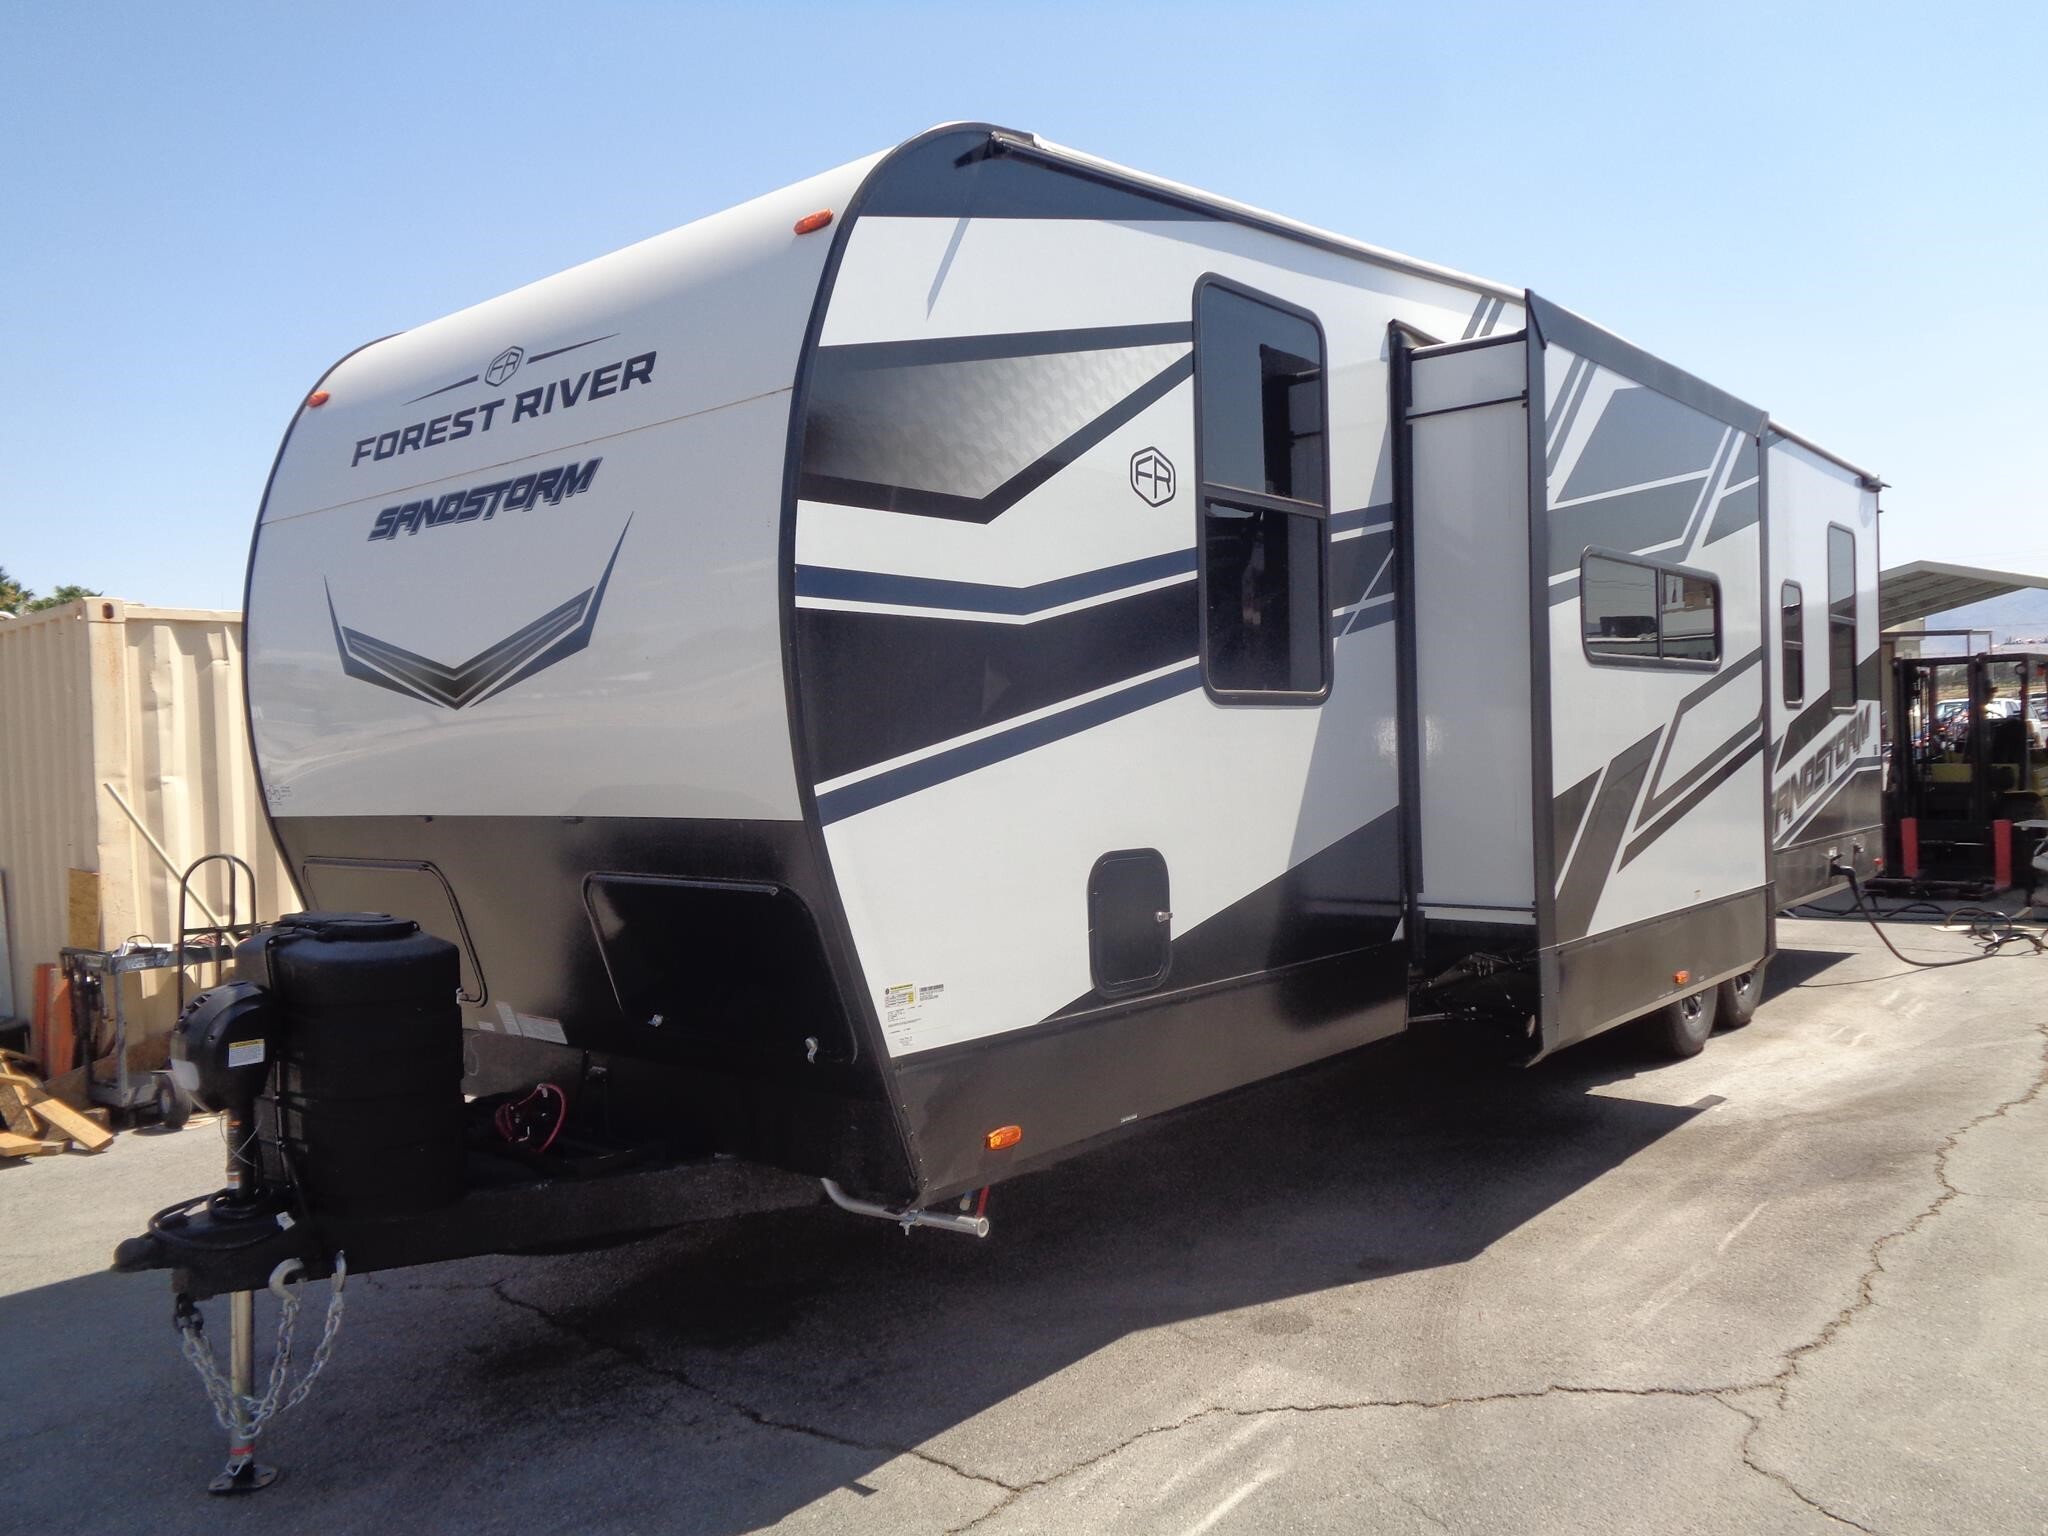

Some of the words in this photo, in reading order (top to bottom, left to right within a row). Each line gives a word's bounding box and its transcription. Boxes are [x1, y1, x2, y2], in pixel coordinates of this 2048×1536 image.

[351, 398, 506, 467] FOREST
[511, 350, 657, 424] RIVER
[367, 456, 603, 542] SANDSTORM
[1772, 702, 1872, 839] ANDSTORM
